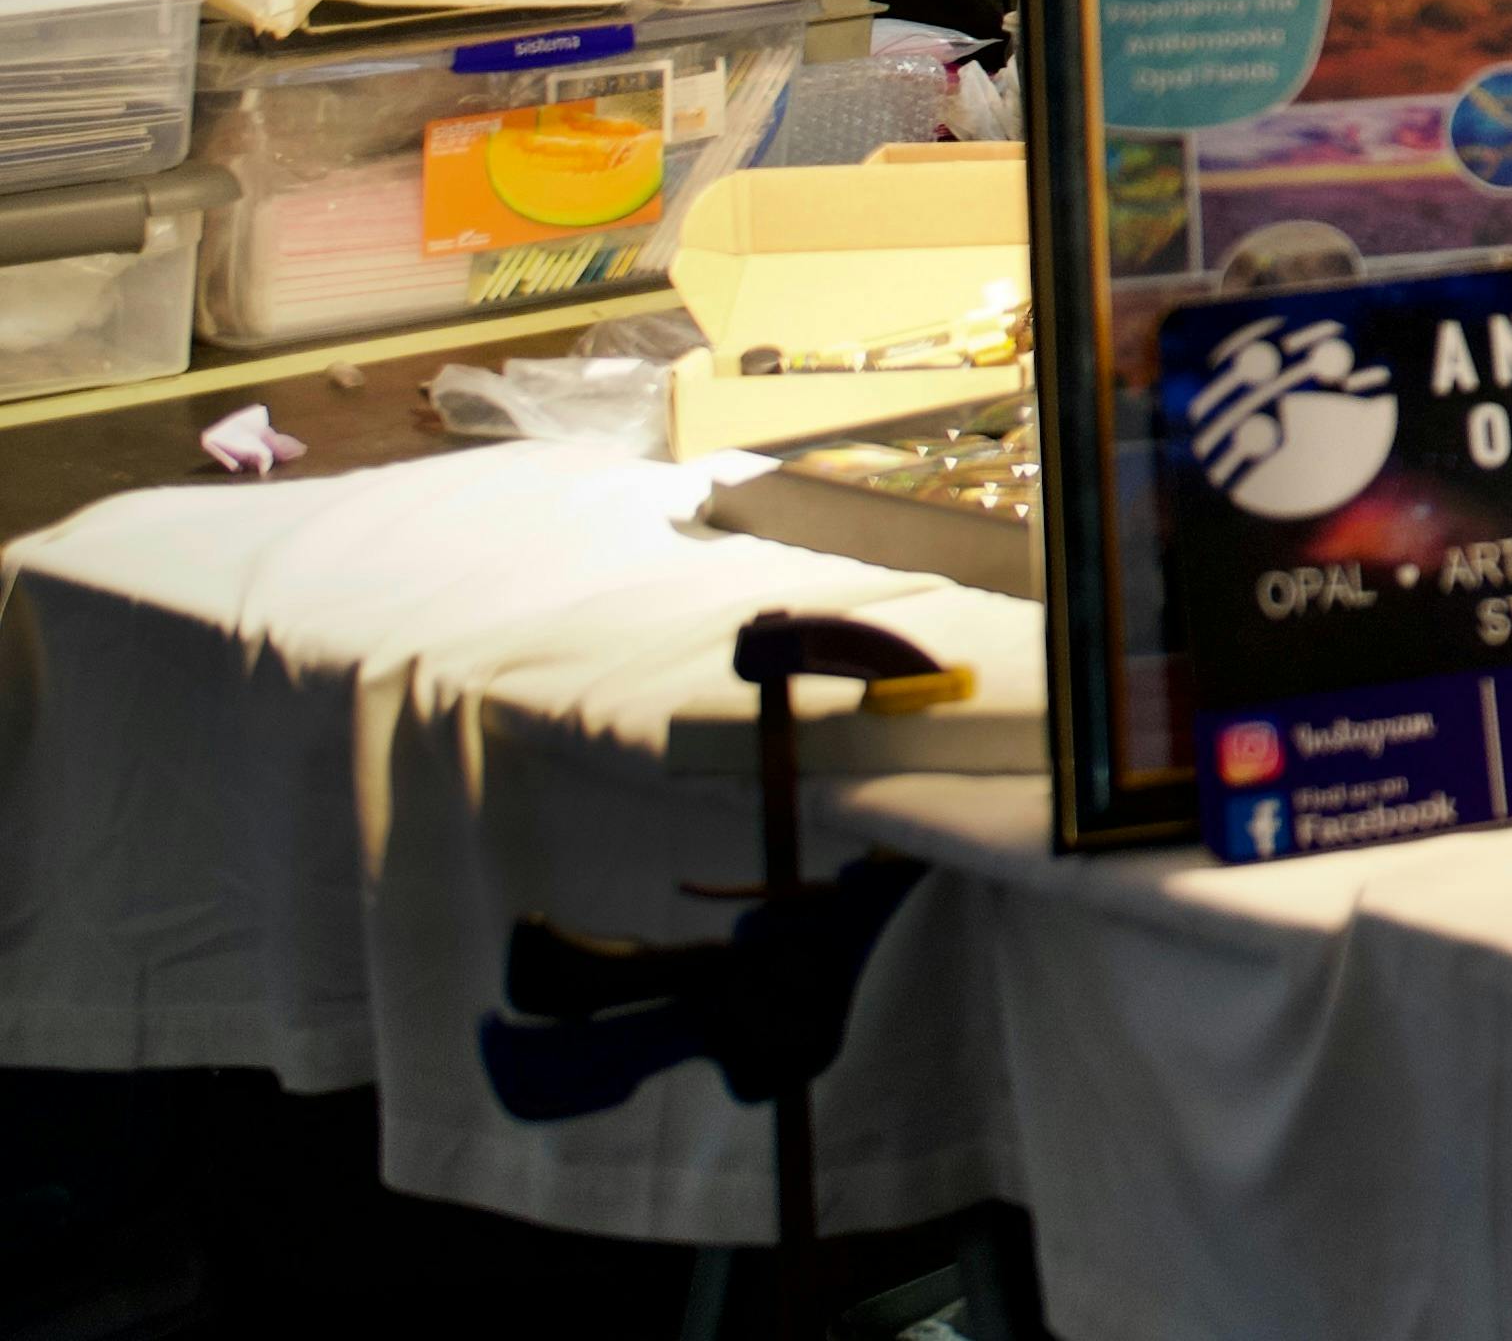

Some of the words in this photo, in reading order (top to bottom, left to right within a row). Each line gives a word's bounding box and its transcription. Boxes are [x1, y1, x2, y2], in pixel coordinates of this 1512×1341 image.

[513, 34, 582, 57] sistema
[1125, 25, 1287, 58] Andamooka
[1132, 67, 1194, 96] Opal
[1200, 59, 1280, 87] Fields
[1255, 560, 1379, 619] OPAL
[1290, 711, 1438, 760] Instagram
[1292, 782, 1348, 813] Find
[1348, 781, 1377, 806] us
[1377, 774, 1410, 801] on
[1294, 789, 1459, 850] Facebook
